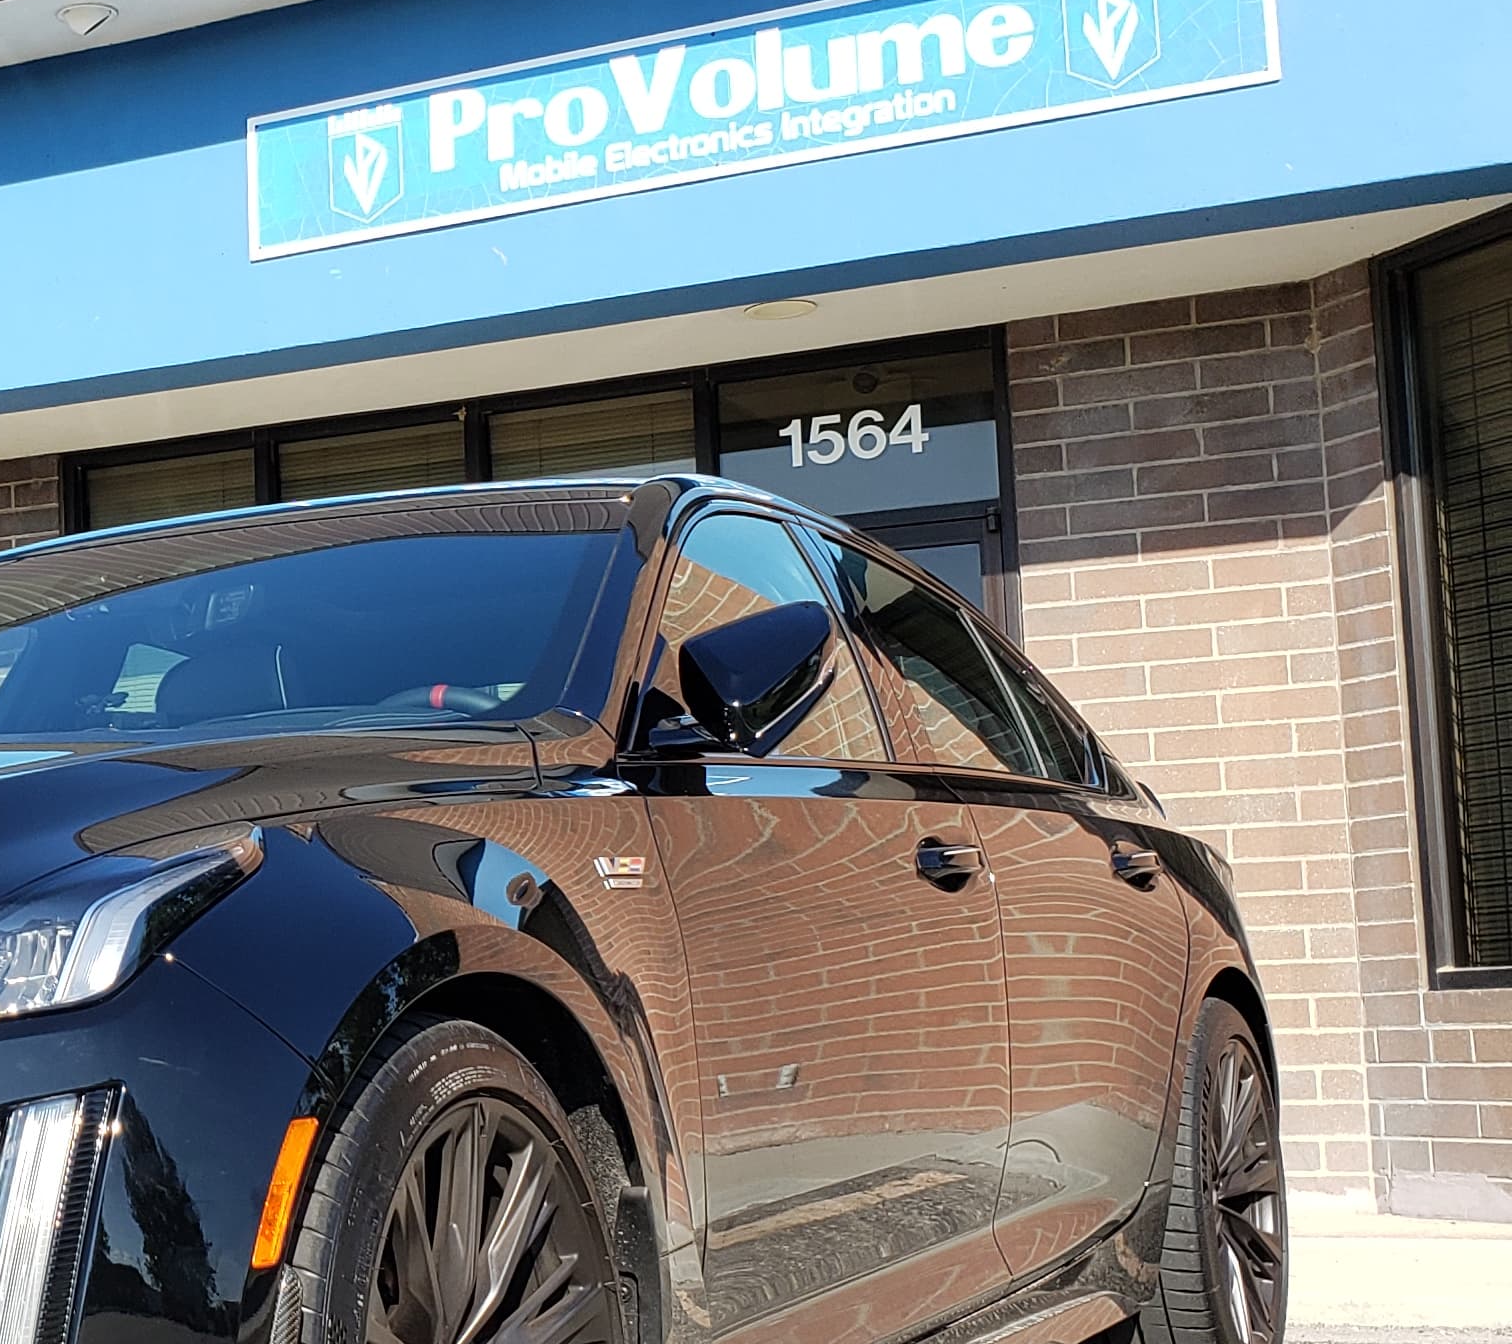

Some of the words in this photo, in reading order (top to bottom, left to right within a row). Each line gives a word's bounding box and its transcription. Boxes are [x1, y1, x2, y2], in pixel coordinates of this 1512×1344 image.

[429, 4, 1034, 173] ProVolume
[498, 150, 599, 193] Mobile
[605, 120, 774, 173] Electronics
[781, 87, 956, 141] Integration
[779, 404, 930, 468] 1564
